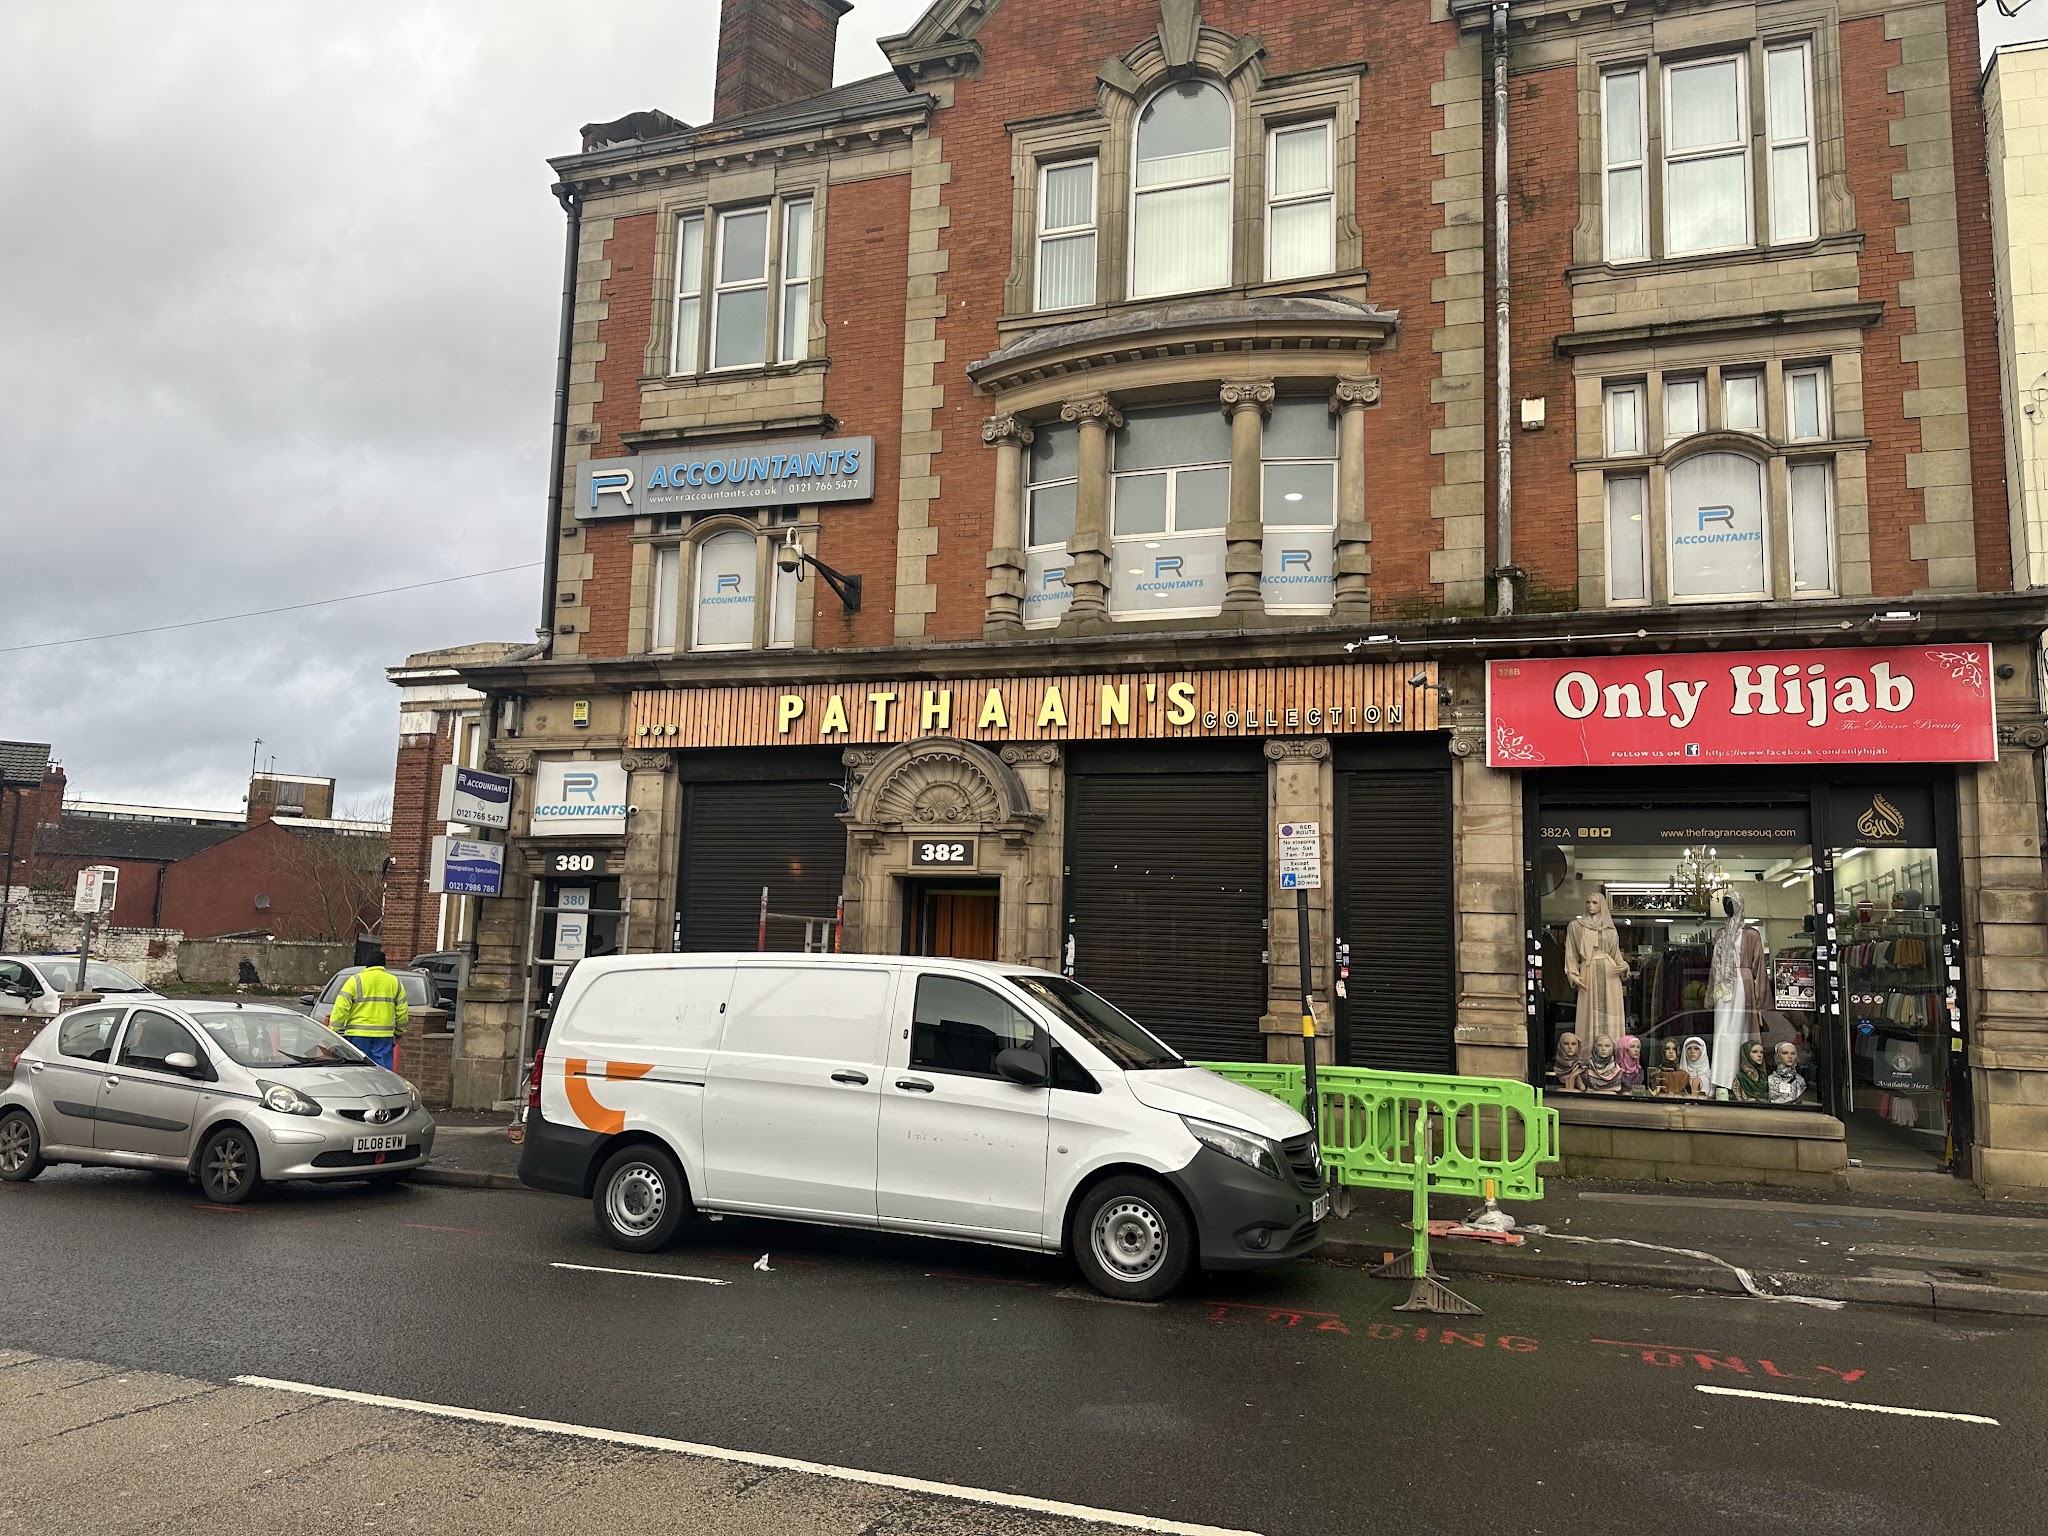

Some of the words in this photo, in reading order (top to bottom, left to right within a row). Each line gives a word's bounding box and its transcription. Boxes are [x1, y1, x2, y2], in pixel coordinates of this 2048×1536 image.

[647, 449, 860, 488] ACCOUNTANTS
[649, 486, 777, 503] www.rraccountants.co.uk
[788, 483, 811, 493] 0121
[815, 481, 832, 491] 766
[835, 479, 859, 490] 5477
[1675, 532, 1761, 545] ACCOUNTANTS
[1135, 579, 1204, 591] ACCOUNTANTS
[1260, 575, 1334, 584] ACCOUNTANTS
[1025, 590, 1073, 603] ACCOUNTAN
[1553, 669, 1709, 729] Only
[1728, 661, 1915, 727] Hijab
[778, 681, 1196, 734] PATHAAN'S
[1202, 704, 1402, 729] COLLECTION
[1836, 719, 1860, 731] The
[1864, 719, 1909, 731] Divine
[1912, 718, 1962, 733] Beauty
[1705, 747, 1888, 758] https://wwwfacebookcom/onlyhijab
[467, 779, 508, 793] ACCOUNTANTS
[456, 808, 472, 818] 0121
[473, 811, 486, 821] 766
[487, 813, 504, 823] 5477
[535, 804, 627, 816] ACCOUNTANTS
[1540, 828, 1571, 838] 382A
[1660, 828, 1796, 839] www.thefragrancesouq.com
[920, 843, 965, 861] 382
[555, 854, 594, 871] 380
[446, 864, 475, 872] Immigration
[474, 866, 499, 875] Specialists
[449, 882, 464, 890] 0121
[464, 883, 481, 892] 7986
[482, 885, 495, 893] 786
[563, 895, 585, 906] 380
[1877, 1080, 1910, 1089] Available
[357, 1138, 384, 1150] DL08
